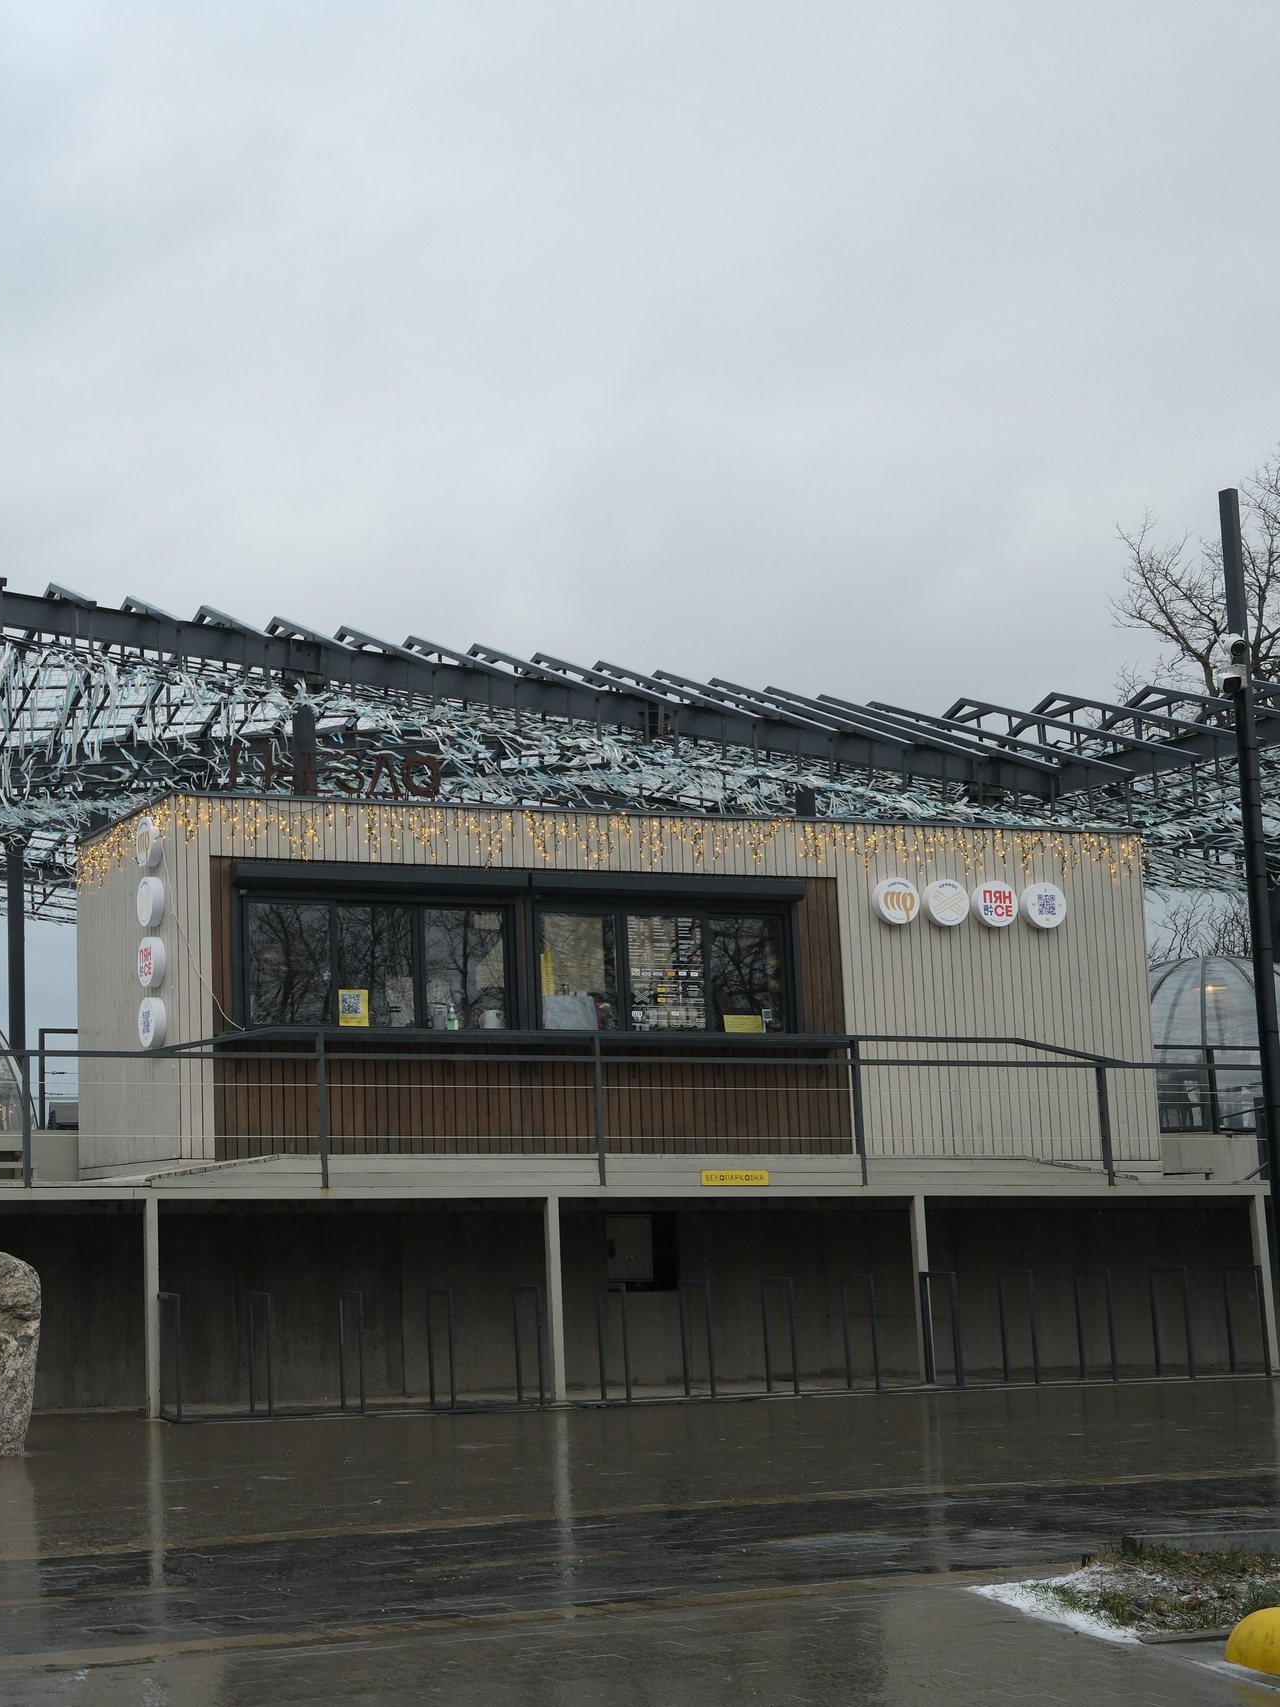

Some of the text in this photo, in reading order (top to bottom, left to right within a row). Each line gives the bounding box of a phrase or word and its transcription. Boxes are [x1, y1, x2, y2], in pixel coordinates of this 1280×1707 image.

[229, 747, 441, 799] ГНЕЗДО
[982, 889, 1013, 904] ПЯН
[994, 904, 1013, 917] СЕ
